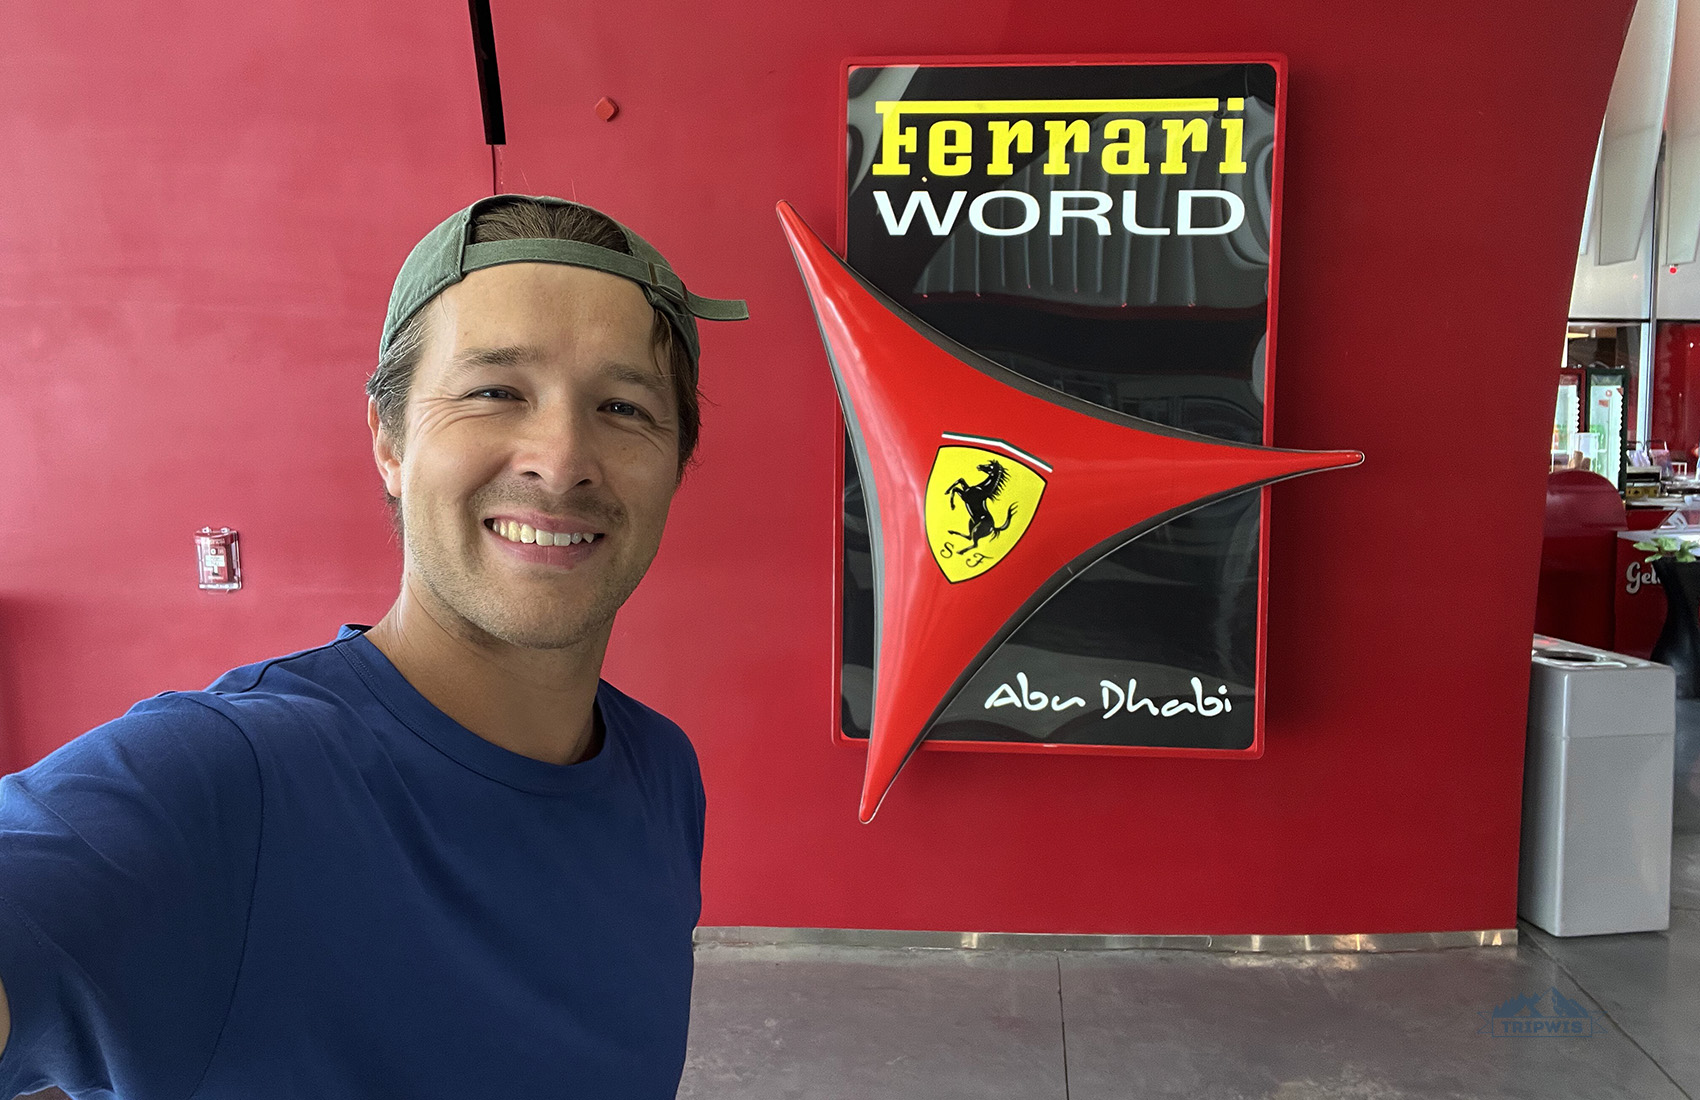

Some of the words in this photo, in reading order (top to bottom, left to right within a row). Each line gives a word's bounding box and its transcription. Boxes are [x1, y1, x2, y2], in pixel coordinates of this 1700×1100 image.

[872, 97, 1247, 176] Ferrari
[872, 190, 1245, 236] WORLD
[940, 541, 954, 559] S
[965, 552, 994, 568] F
[1626, 561, 1662, 594] Gel
[984, 671, 1086, 711] Abu
[1100, 676, 1232, 720] Dhabi
